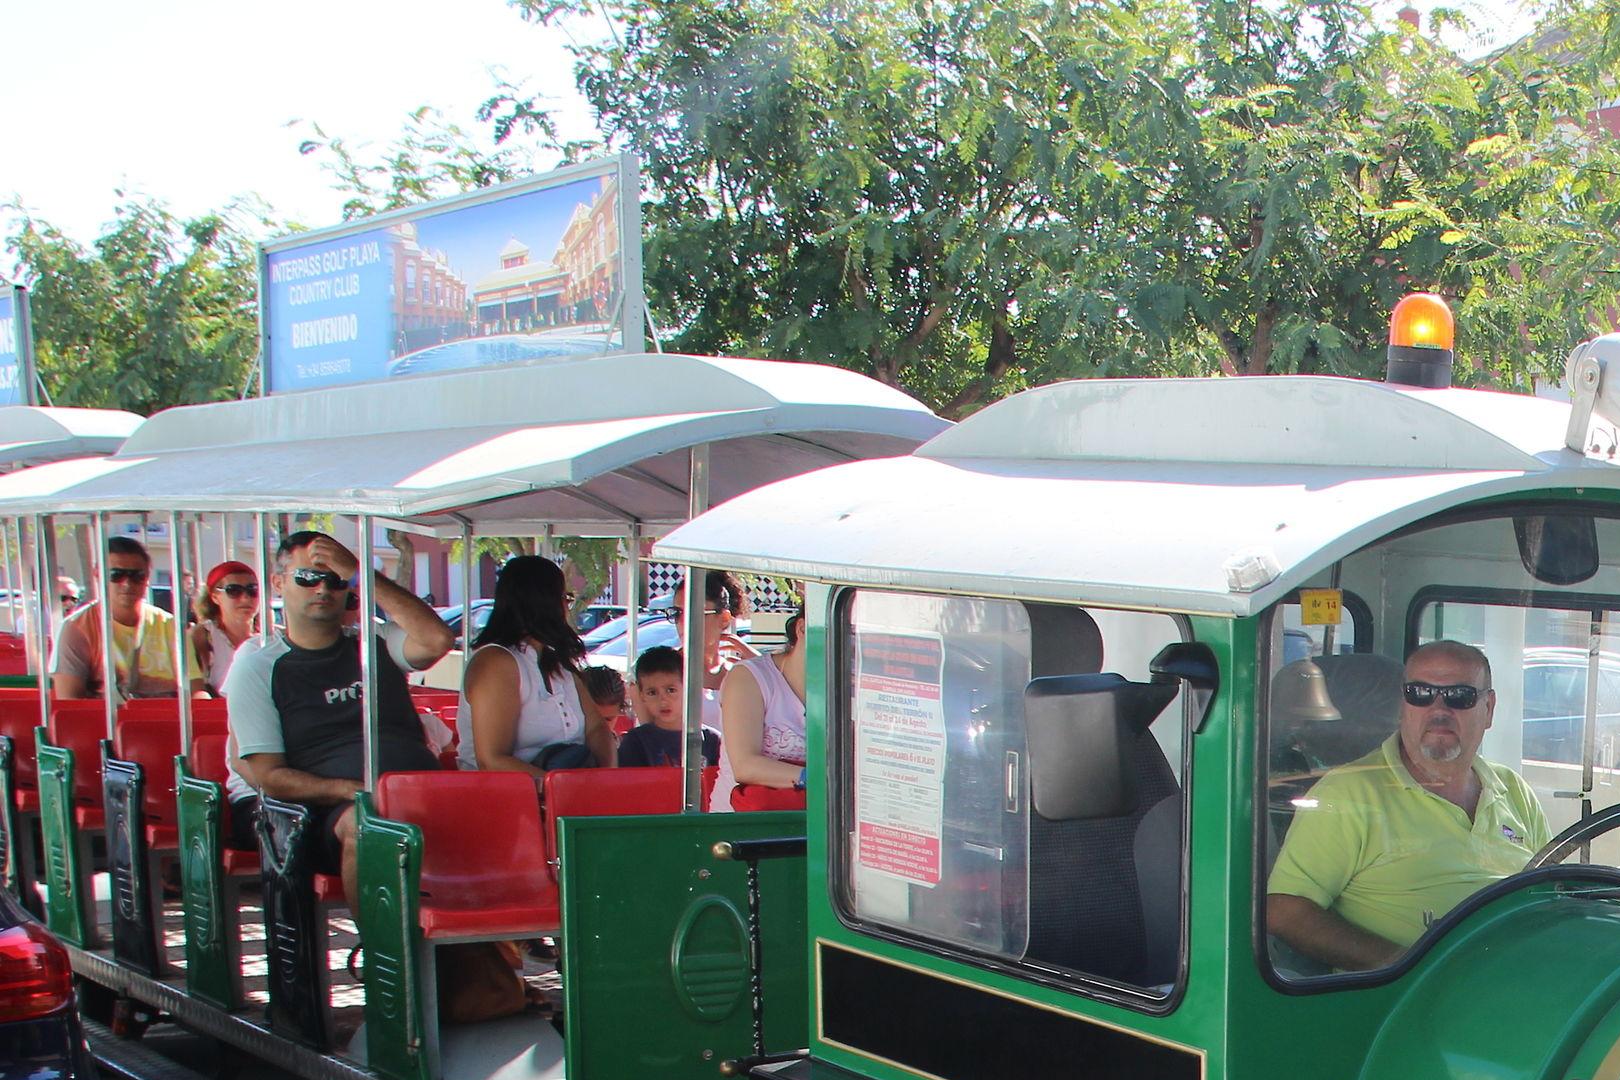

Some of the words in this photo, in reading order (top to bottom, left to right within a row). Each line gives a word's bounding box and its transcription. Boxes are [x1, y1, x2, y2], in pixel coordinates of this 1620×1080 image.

[271, 254, 321, 283] INTERPASS
[323, 247, 348, 273] GOLF
[350, 241, 381, 267] PLAYA
[289, 279, 332, 306] COUNTRY
[334, 272, 360, 298] CLUB
[291, 313, 358, 349] BIENVENIDO
